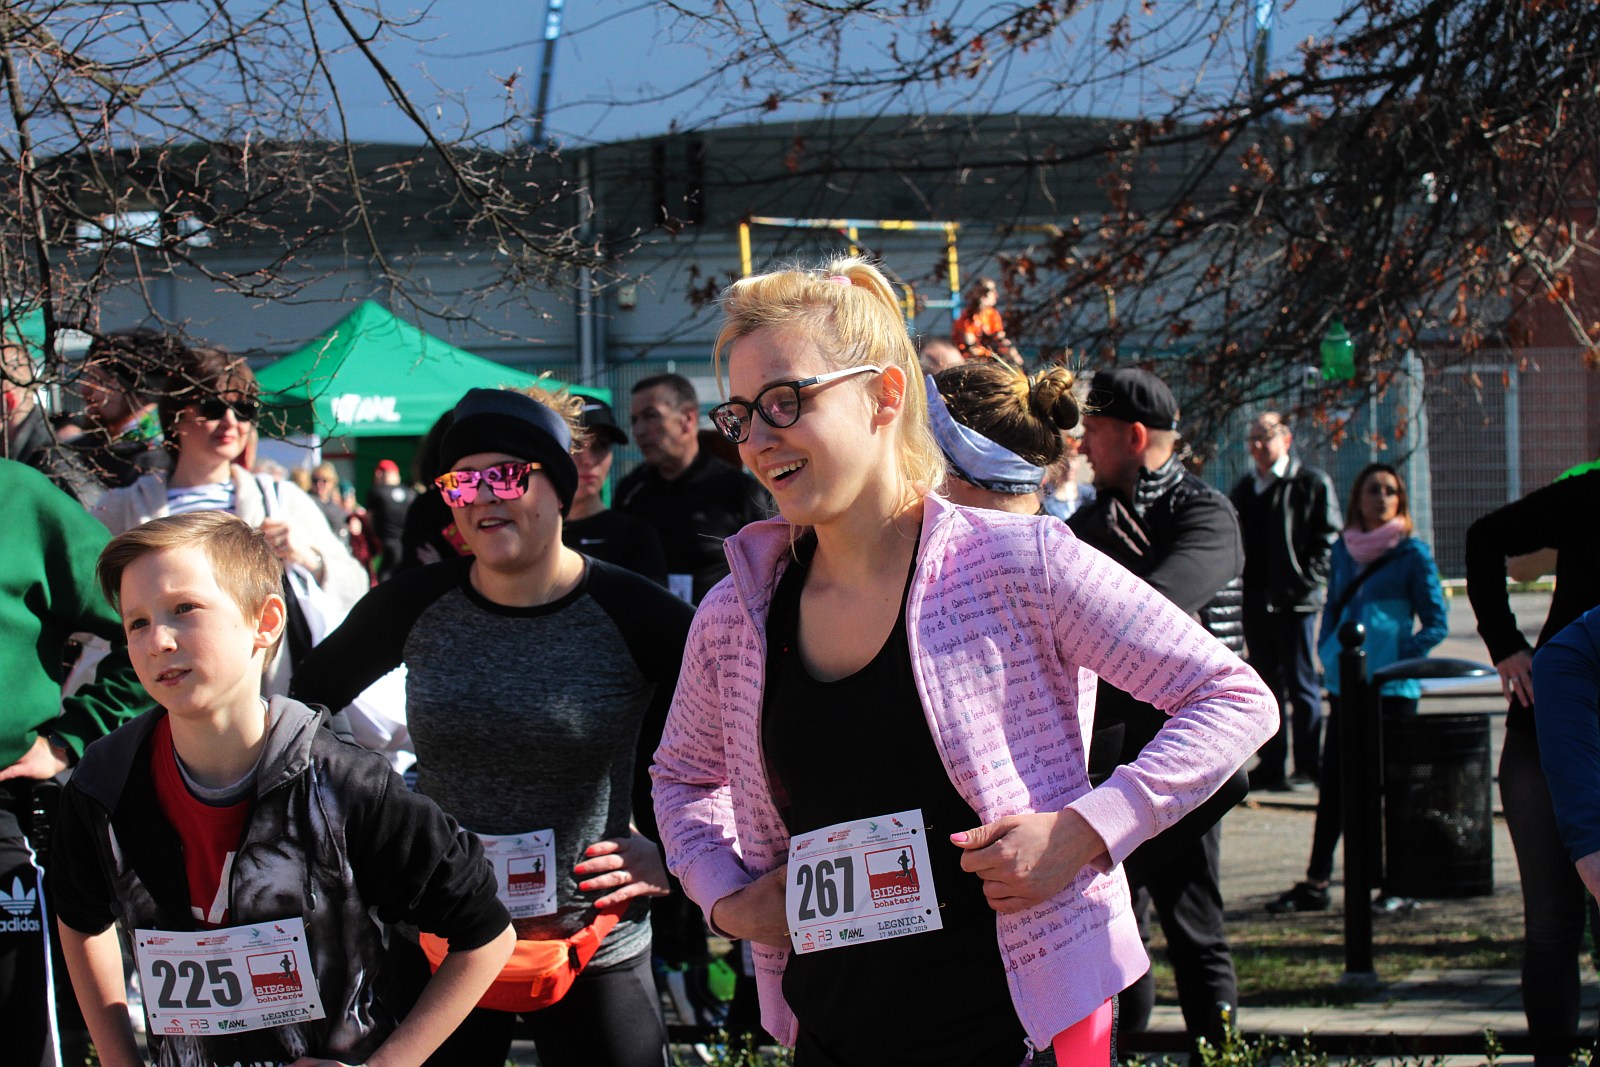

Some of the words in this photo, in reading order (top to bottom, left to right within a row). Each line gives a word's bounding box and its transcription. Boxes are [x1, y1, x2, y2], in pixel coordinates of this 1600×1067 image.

[796, 856, 854, 921] 267
[872, 885, 902, 899] BIEG
[902, 885, 918, 894] stu
[873, 894, 921, 909] bohaterów
[0, 917, 40, 932] adidas
[877, 915, 926, 931] LEGNICA
[848, 927, 865, 938] AWL
[889, 928, 912, 938] MARCA
[914, 925, 928, 933] 2019
[152, 958, 243, 1009] 225
[255, 984, 285, 996] BIEG
[257, 992, 304, 1004] bohaterów
[261, 1008, 309, 1021] LEGNICA
[272, 1017, 297, 1025] MARCA
[228, 1019, 248, 1029] AWL
